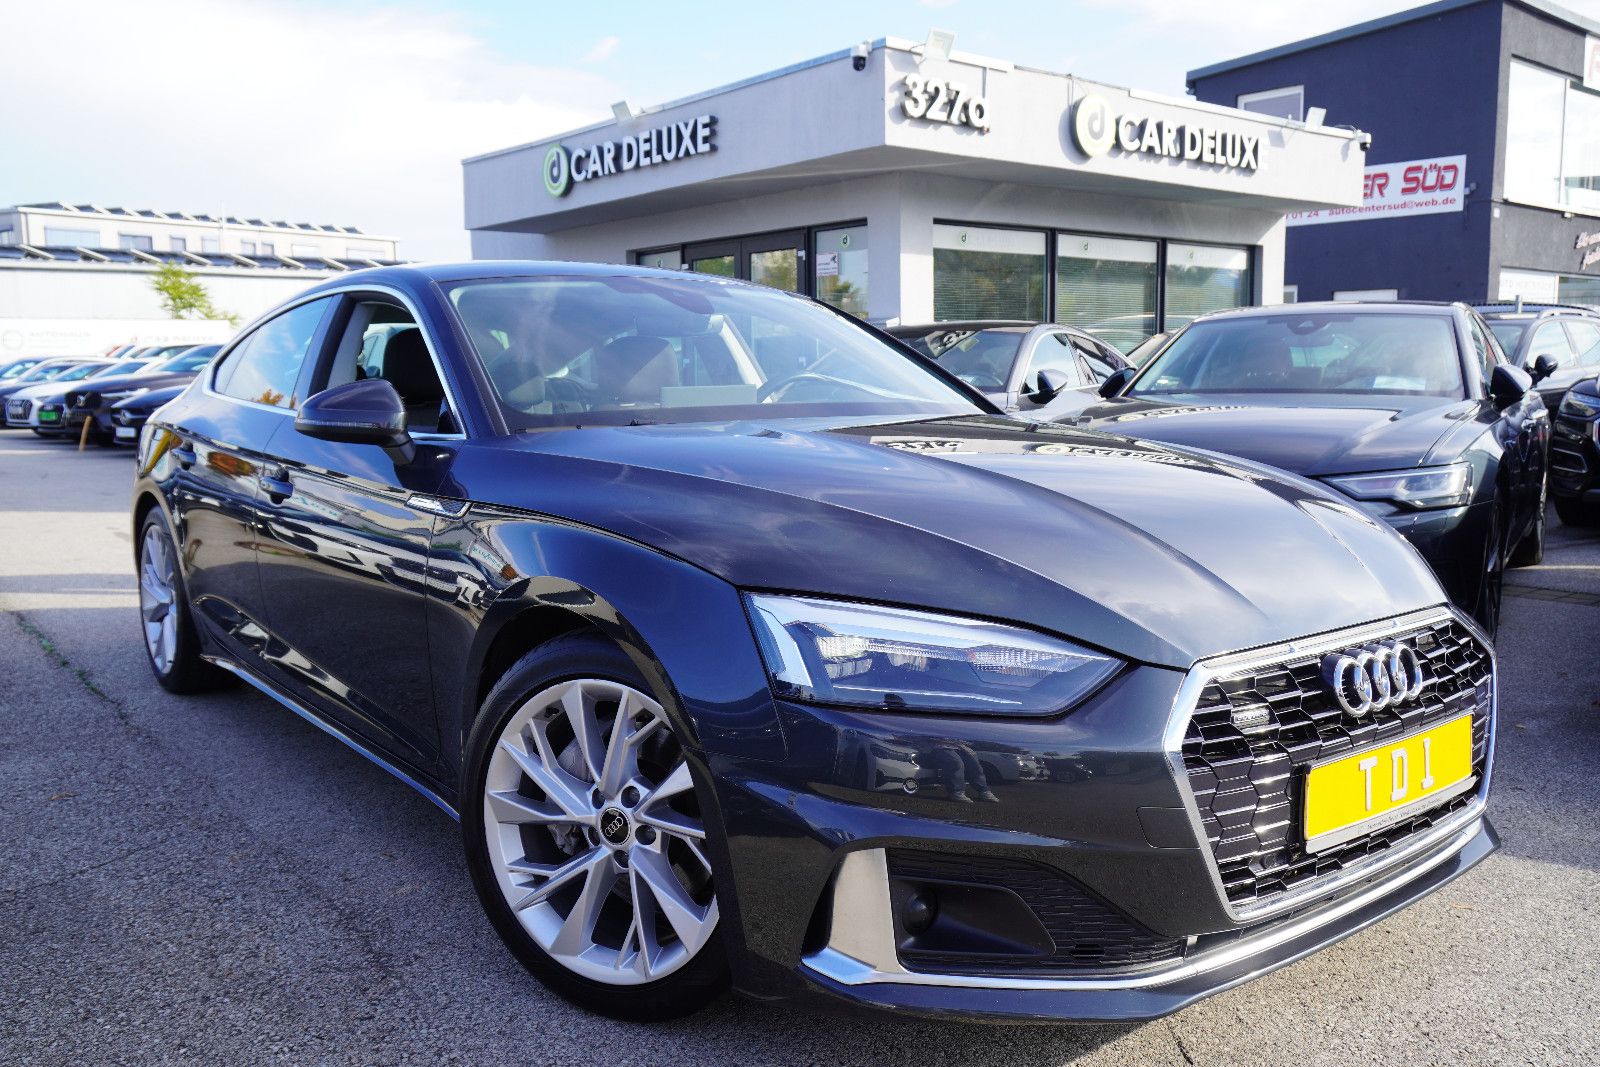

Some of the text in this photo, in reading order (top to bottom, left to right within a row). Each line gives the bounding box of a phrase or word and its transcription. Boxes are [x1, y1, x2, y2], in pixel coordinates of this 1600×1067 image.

[570, 140, 616, 182] CAR
[622, 115, 711, 171] DELUXE
[1118, 112, 1180, 158] CAR
[1184, 124, 1269, 170] DELUXE
[1401, 163, 1459, 195] SÜD
[1328, 197, 1457, 216] autocentersud@web.de
